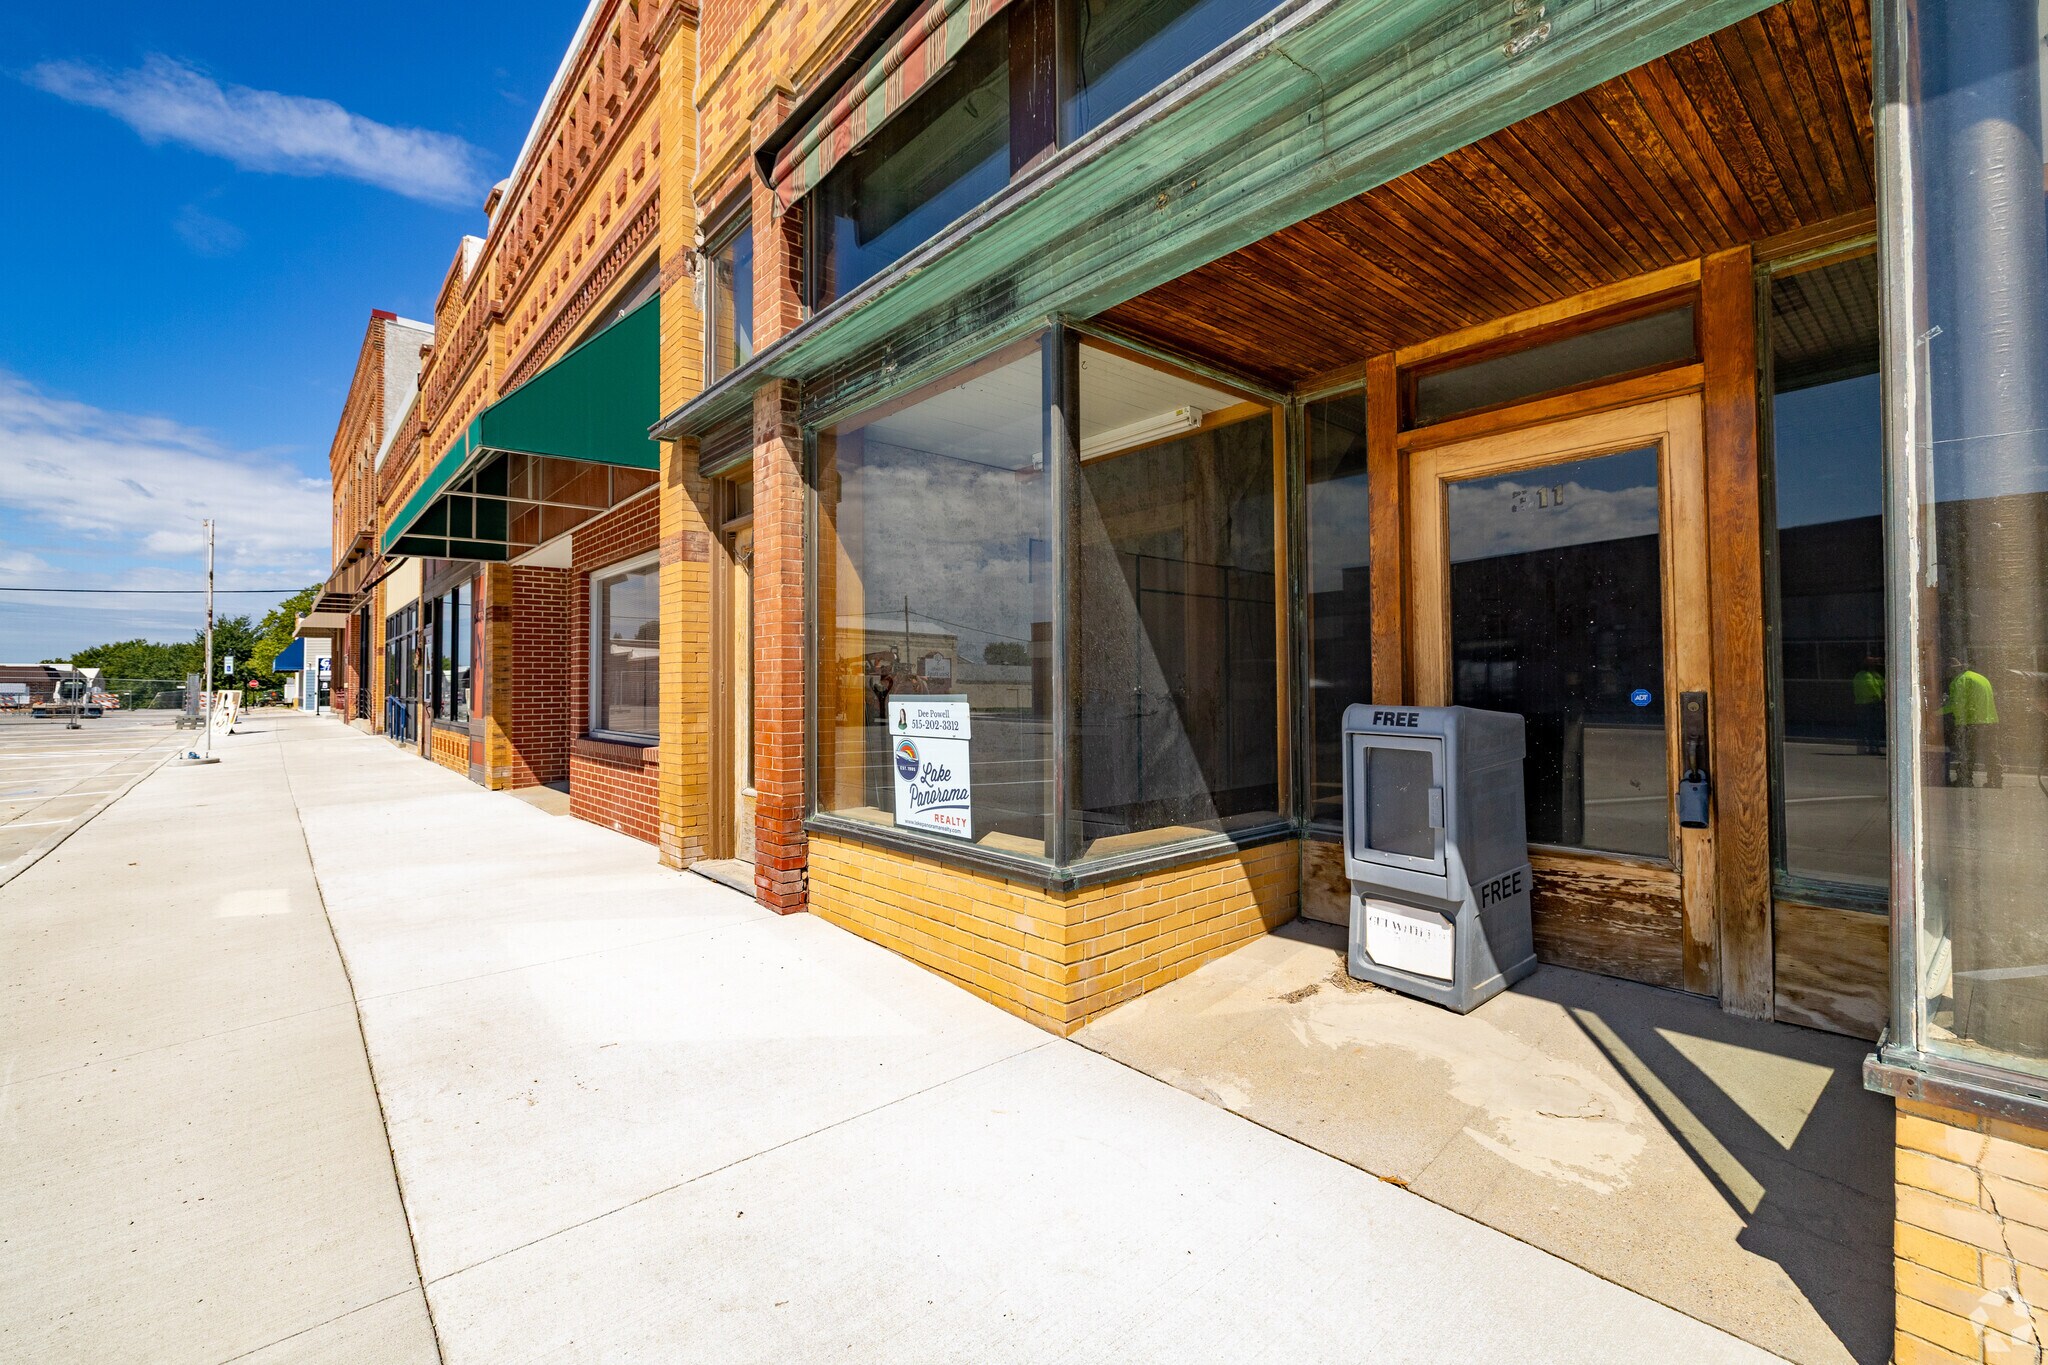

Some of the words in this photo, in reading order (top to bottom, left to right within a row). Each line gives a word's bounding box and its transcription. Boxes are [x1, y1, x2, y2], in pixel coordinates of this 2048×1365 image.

[1512, 484, 1563, 512] 11
[917, 709, 929, 718] Dee
[930, 709, 950, 719] Powell
[1372, 711, 1420, 728] FREE
[911, 719, 959, 731] 515-202-3312
[920, 762, 952, 788] Lake
[909, 783, 970, 809] Panorama
[934, 813, 967, 828] REALTY
[1481, 871, 1522, 909] FREE
